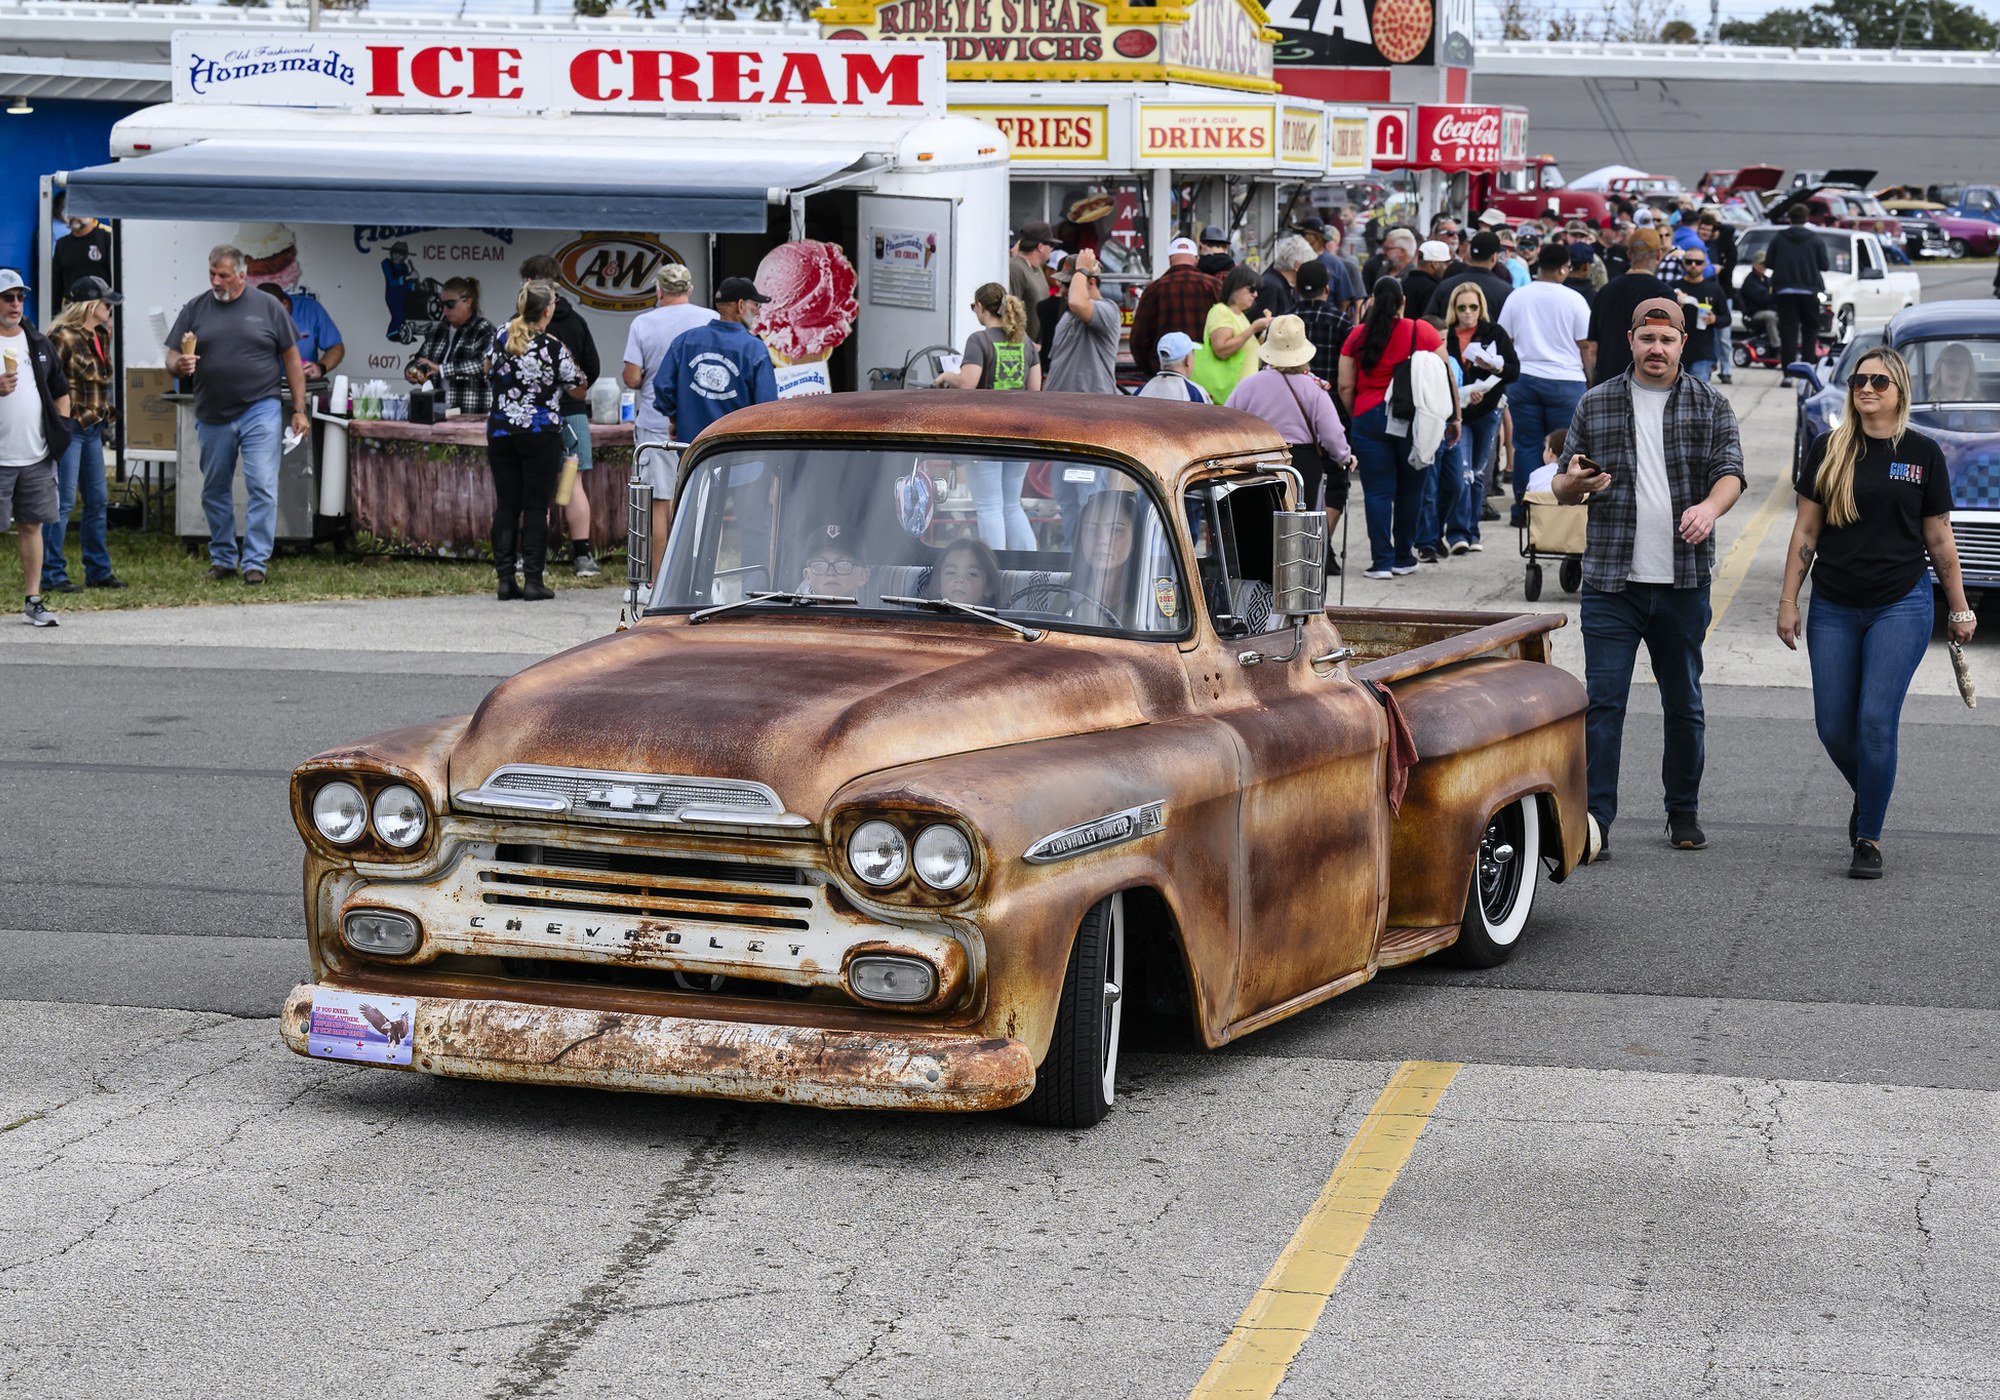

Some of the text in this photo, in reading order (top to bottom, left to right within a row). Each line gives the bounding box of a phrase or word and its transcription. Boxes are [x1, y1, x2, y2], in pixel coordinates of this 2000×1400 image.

[879, 0, 1102, 34] RIBEYE STEAK
[224, 43, 315, 63] Old Fashioned
[189, 49, 355, 95] Homemade
[365, 46, 925, 106] ICE CREAM
[1148, 126, 1267, 149] DRINKS
[1430, 148, 1442, 162] &
[423, 244, 505, 262] ICE CREAM
[576, 249, 665, 290] A&W
[367, 353, 401, 370] (407)
[1051, 818, 1129, 854] CHEVROLET APACHE
[469, 916, 806, 957] CHEVROLET
